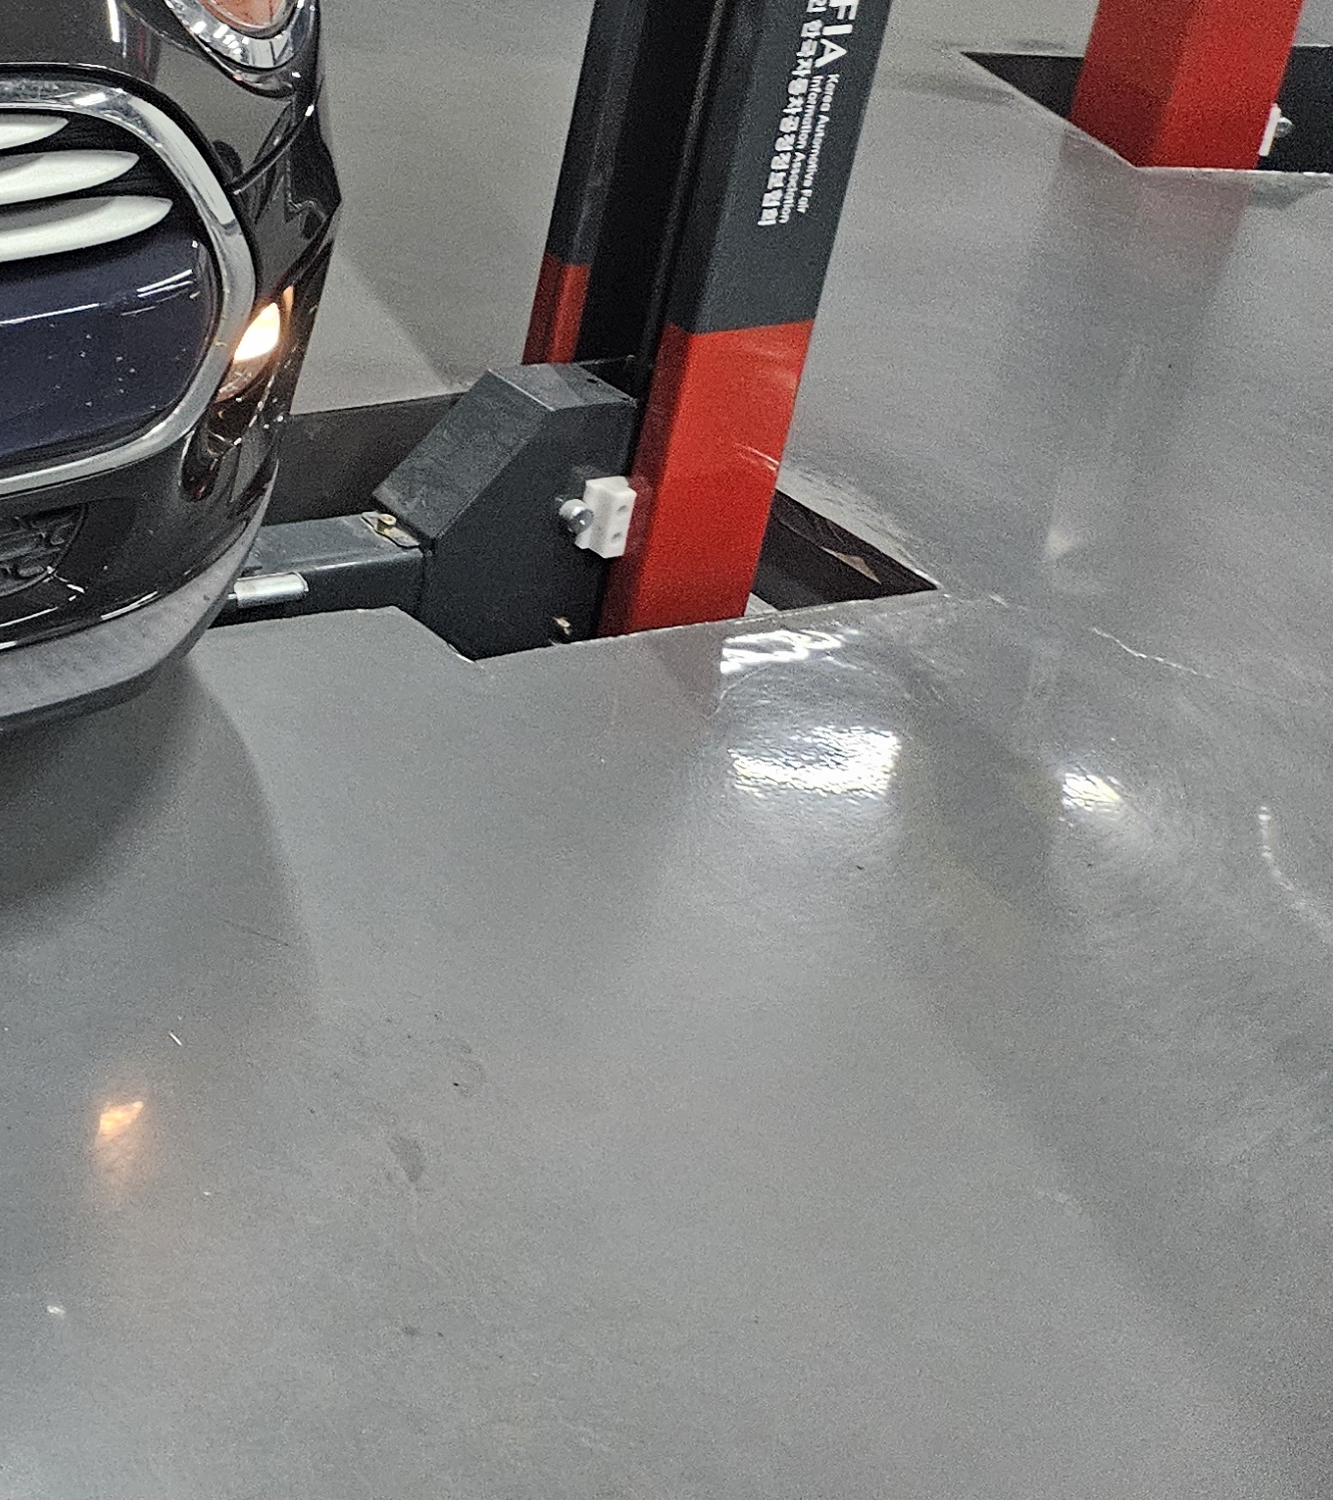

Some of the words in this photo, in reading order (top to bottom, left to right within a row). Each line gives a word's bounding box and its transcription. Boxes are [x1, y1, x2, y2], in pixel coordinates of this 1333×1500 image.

[796, 74, 824, 150] Information
[820, 73, 840, 112] Korea
[802, 113, 831, 188] Automotive
[778, 151, 807, 225] Association
[796, 188, 814, 214] Fair
